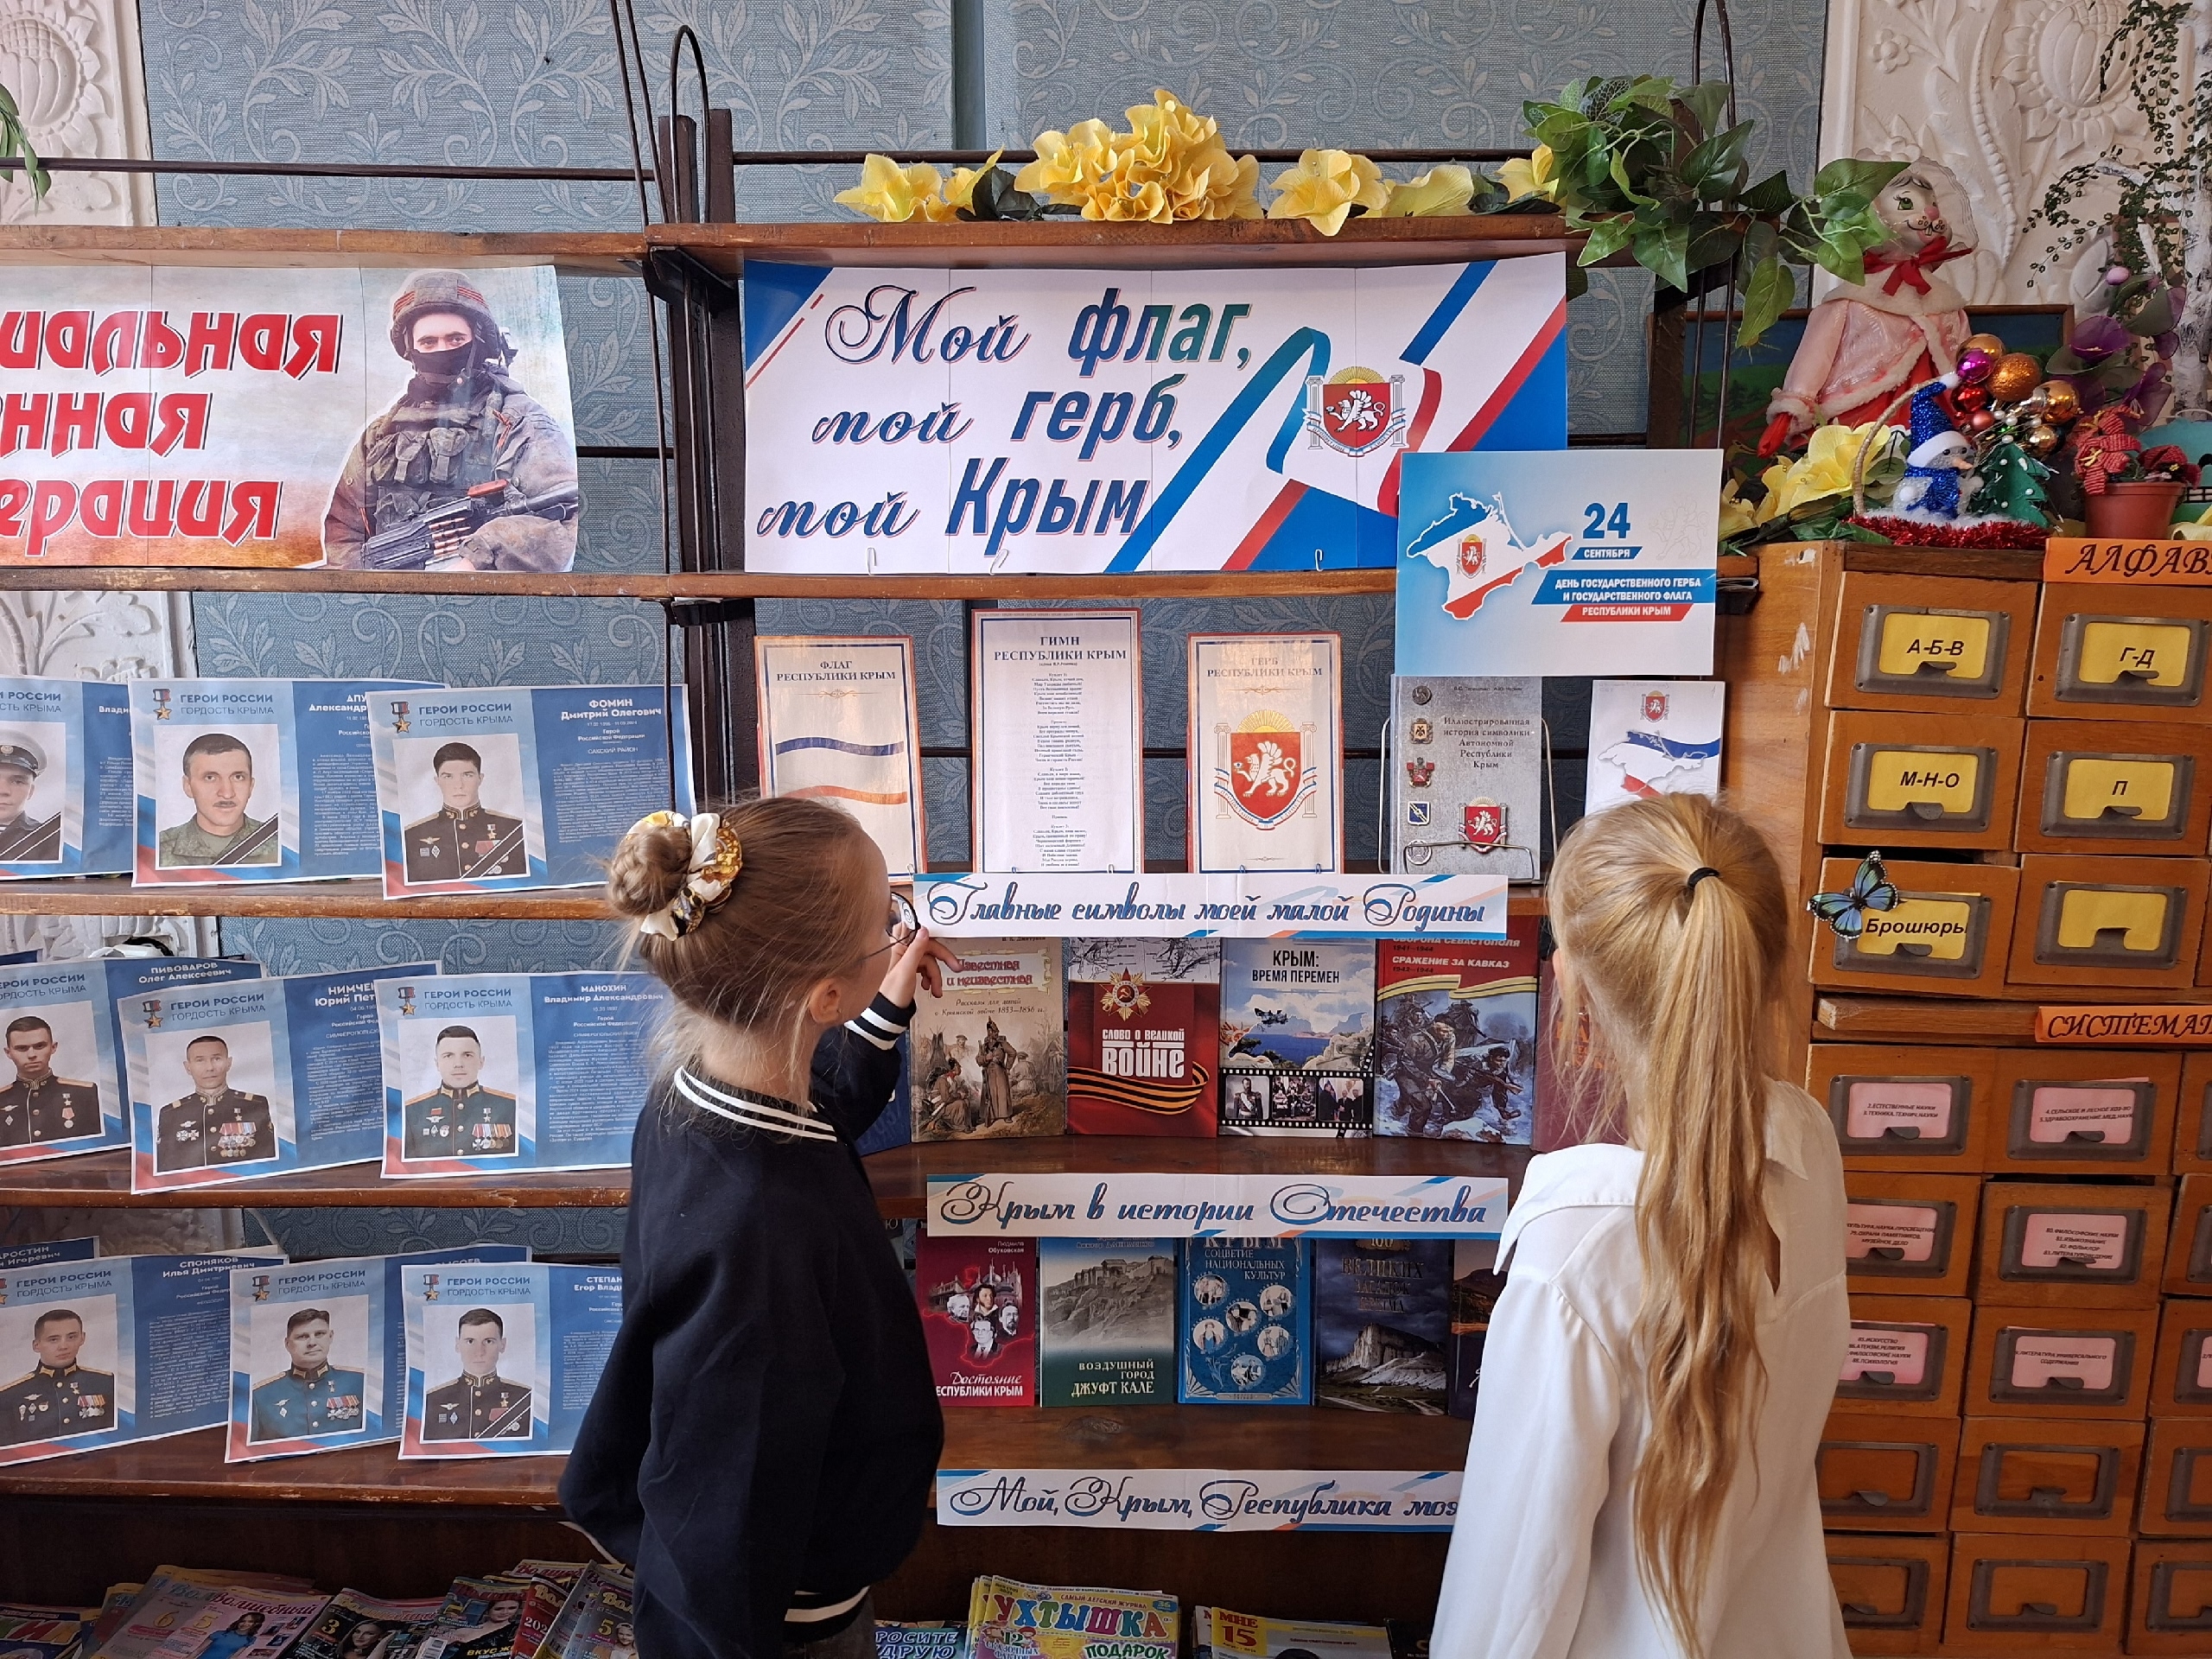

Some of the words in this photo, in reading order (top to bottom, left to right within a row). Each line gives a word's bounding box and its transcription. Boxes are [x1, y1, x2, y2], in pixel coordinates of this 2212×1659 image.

[824, 284, 1033, 364] Мой
[1068, 288, 1252, 378] флаг,
[811, 401, 975, 444] мой
[1010, 372, 1188, 461] герб,
[755, 491, 921, 538] мой
[944, 457, 1150, 557] Крым
[1582, 502, 1631, 539] 24
[1583, 549, 1631, 559] СЕНТЯБРЯ
[2064, 543, 2212, 578] АЛФАВ
[1555, 578, 1580, 589] ДЕНЬ
[1580, 577, 1671, 589] ГОСУДАРСТВЕННОГО
[1672, 577, 1702, 588] ГЕРБА
[1562, 592, 1570, 601] И
[1571, 591, 1662, 602] ГОСУДАРСТВЕННОГО
[1663, 590, 1693, 601] ФЛАГА
[1581, 605, 1642, 616] РЕСПУБЛИКИ
[1642, 605, 1671, 616] КРЫМ
[1039, 636, 1080, 646] ГИМН
[1905, 639, 1965, 658] А-Б-В
[994, 650, 1083, 661] РЕСПУБЛИКИ
[1086, 650, 1127, 660] КРЫМ
[1251, 657, 1279, 665] ГЕРБ
[2120, 646, 2156, 669] Г-Д
[819, 660, 852, 670] ФЛАГ
[776, 672, 857, 682] РЕСПУБЛИКИ
[860, 671, 896, 681] КРЫМ
[1206, 669, 1284, 677] РЕСПУБЛИКИ
[1287, 668, 1323, 677] КРЫМ
[8, 691, 61, 702] РОССИИ
[180, 694, 219, 703] ГЕРОИ
[222, 694, 274, 703] РОССИИ
[22, 703, 62, 713] КРЫМА
[418, 705, 458, 715] ГЕРОИ
[461, 702, 512, 713] РОССИИ
[588, 698, 633, 709] ФОМИН
[181, 707, 235, 715] ГОРДОСТЬ
[561, 709, 609, 721] Дмитрий
[611, 708, 662, 717] Олегович
[419, 717, 474, 728] ГОРДОСТЬ
[476, 715, 514, 725] КРЫМА
[1443, 716, 1530, 727] Иллюстрированная
[1443, 728, 1479, 738] история
[1482, 728, 1530, 737] символики
[1459, 739, 1514, 747] Автономной
[1460, 749, 1512, 760] Республики
[1473, 760, 1499, 770] Крым
[1899, 771, 1961, 788] М-Н-О
[2111, 779, 2128, 796] П
[927, 880, 1063, 926] Главные
[1071, 881, 1186, 920] символы
[1193, 895, 1262, 921] моей
[1267, 895, 1354, 921] малой
[1363, 883, 1486, 931] Родины
[1273, 950, 1319, 968] КРЫМ:
[1392, 956, 1449, 966] СРАЖЕНИЕ
[1467, 959, 1510, 969] КАВКАЗ
[149, 962, 219, 974] ПИВОВАРОВ
[32, 973, 86, 986] РОССИИ
[138, 975, 164, 984] Олег
[168, 968, 232, 981] Алексеевич
[957, 975, 1033, 987] неизвестная
[1252, 969, 1287, 982] ВРЕМЯ
[1290, 969, 1340, 983] ПЕРЕМЕН
[48, 984, 87, 995] КРЫМА
[423, 991, 461, 1000] ГЕРОИ
[463, 988, 512, 998] РОССИИ
[581, 984, 627, 994] МАНОХИН
[170, 999, 210, 1011] ГЕРОИ
[213, 994, 264, 1005] РОССИИ
[315, 995, 351, 1007] Юрий
[424, 1001, 475, 1011] ГОРДОСТЬ
[478, 1000, 513, 1008] КРЫМА
[543, 995, 591, 1004] Владимир
[593, 994, 664, 1002] Александрович
[172, 1009, 226, 1022] ГОРДОСТЬ
[228, 1004, 266, 1015] КРЫМА
[941, 1181, 1075, 1230] Крым
[1087, 1181, 1109, 1221] в
[1118, 1201, 1255, 1232] истории
[1269, 1184, 1486, 1227] Отечества
[8, 1252, 60, 1265] Игоревич
[1205, 1249, 1254, 1259] СОЦВЕТИЕ
[179, 1256, 239, 1268] СПОНЯКОВ
[1205, 1260, 1286, 1270] НАЦИОНАЛЬНЫХ
[1341, 1257, 1425, 1280] ВЕЛИКИХ
[162, 1268, 189, 1278] Илья
[191, 1262, 255, 1275] Дмитриевич
[1244, 1272, 1286, 1281] КУЛЬТУР
[16, 1276, 56, 1287] ГЕРОИ
[60, 1270, 111, 1283] РОССИИ
[277, 1274, 315, 1286] ГЕРОИ
[318, 1269, 365, 1281] РОССИИ
[485, 1276, 531, 1286] РОССИИ
[17, 1285, 73, 1297] ГОРДОСТЬ
[74, 1280, 112, 1291] КРЫМА
[277, 1284, 329, 1295] ГОРДОСТЬ
[330, 1280, 365, 1289] КРЫМА
[447, 1288, 496, 1297] ГОРДОСТЬ
[574, 1284, 595, 1293] Егор
[1078, 1358, 1154, 1371] ВОЗДУШНЫЙ
[950, 1371, 1023, 1385] Достояние
[1121, 1370, 1154, 1380] ГОРОД
[936, 1385, 993, 1398] ЕСПУБЛИКИ
[994, 1385, 1024, 1396] КРЫМ
[1071, 1382, 1117, 1398] ДЖУФТ
[1121, 1382, 1154, 1394] КАЛЕ
[950, 1476, 1059, 1516] Мой,
[1065, 1476, 1192, 1522] Крым,
[1198, 1479, 1392, 1523] Республика
[1060, 1593, 1086, 1602] САМЫЙ
[1087, 1596, 1116, 1606] ДЕТСКИЙ
[1117, 1599, 1147, 1610] ЖУРНАЛ
[993, 1593, 1169, 1639] УХТЫШКА
[1218, 1611, 1258, 1628] МНЕ
[321, 1618, 340, 1635] 3
[598, 1619, 615, 1637] 5
[1222, 1625, 1258, 1647] 15
[1084, 1642, 1170, 1659] ПОДАРОК
